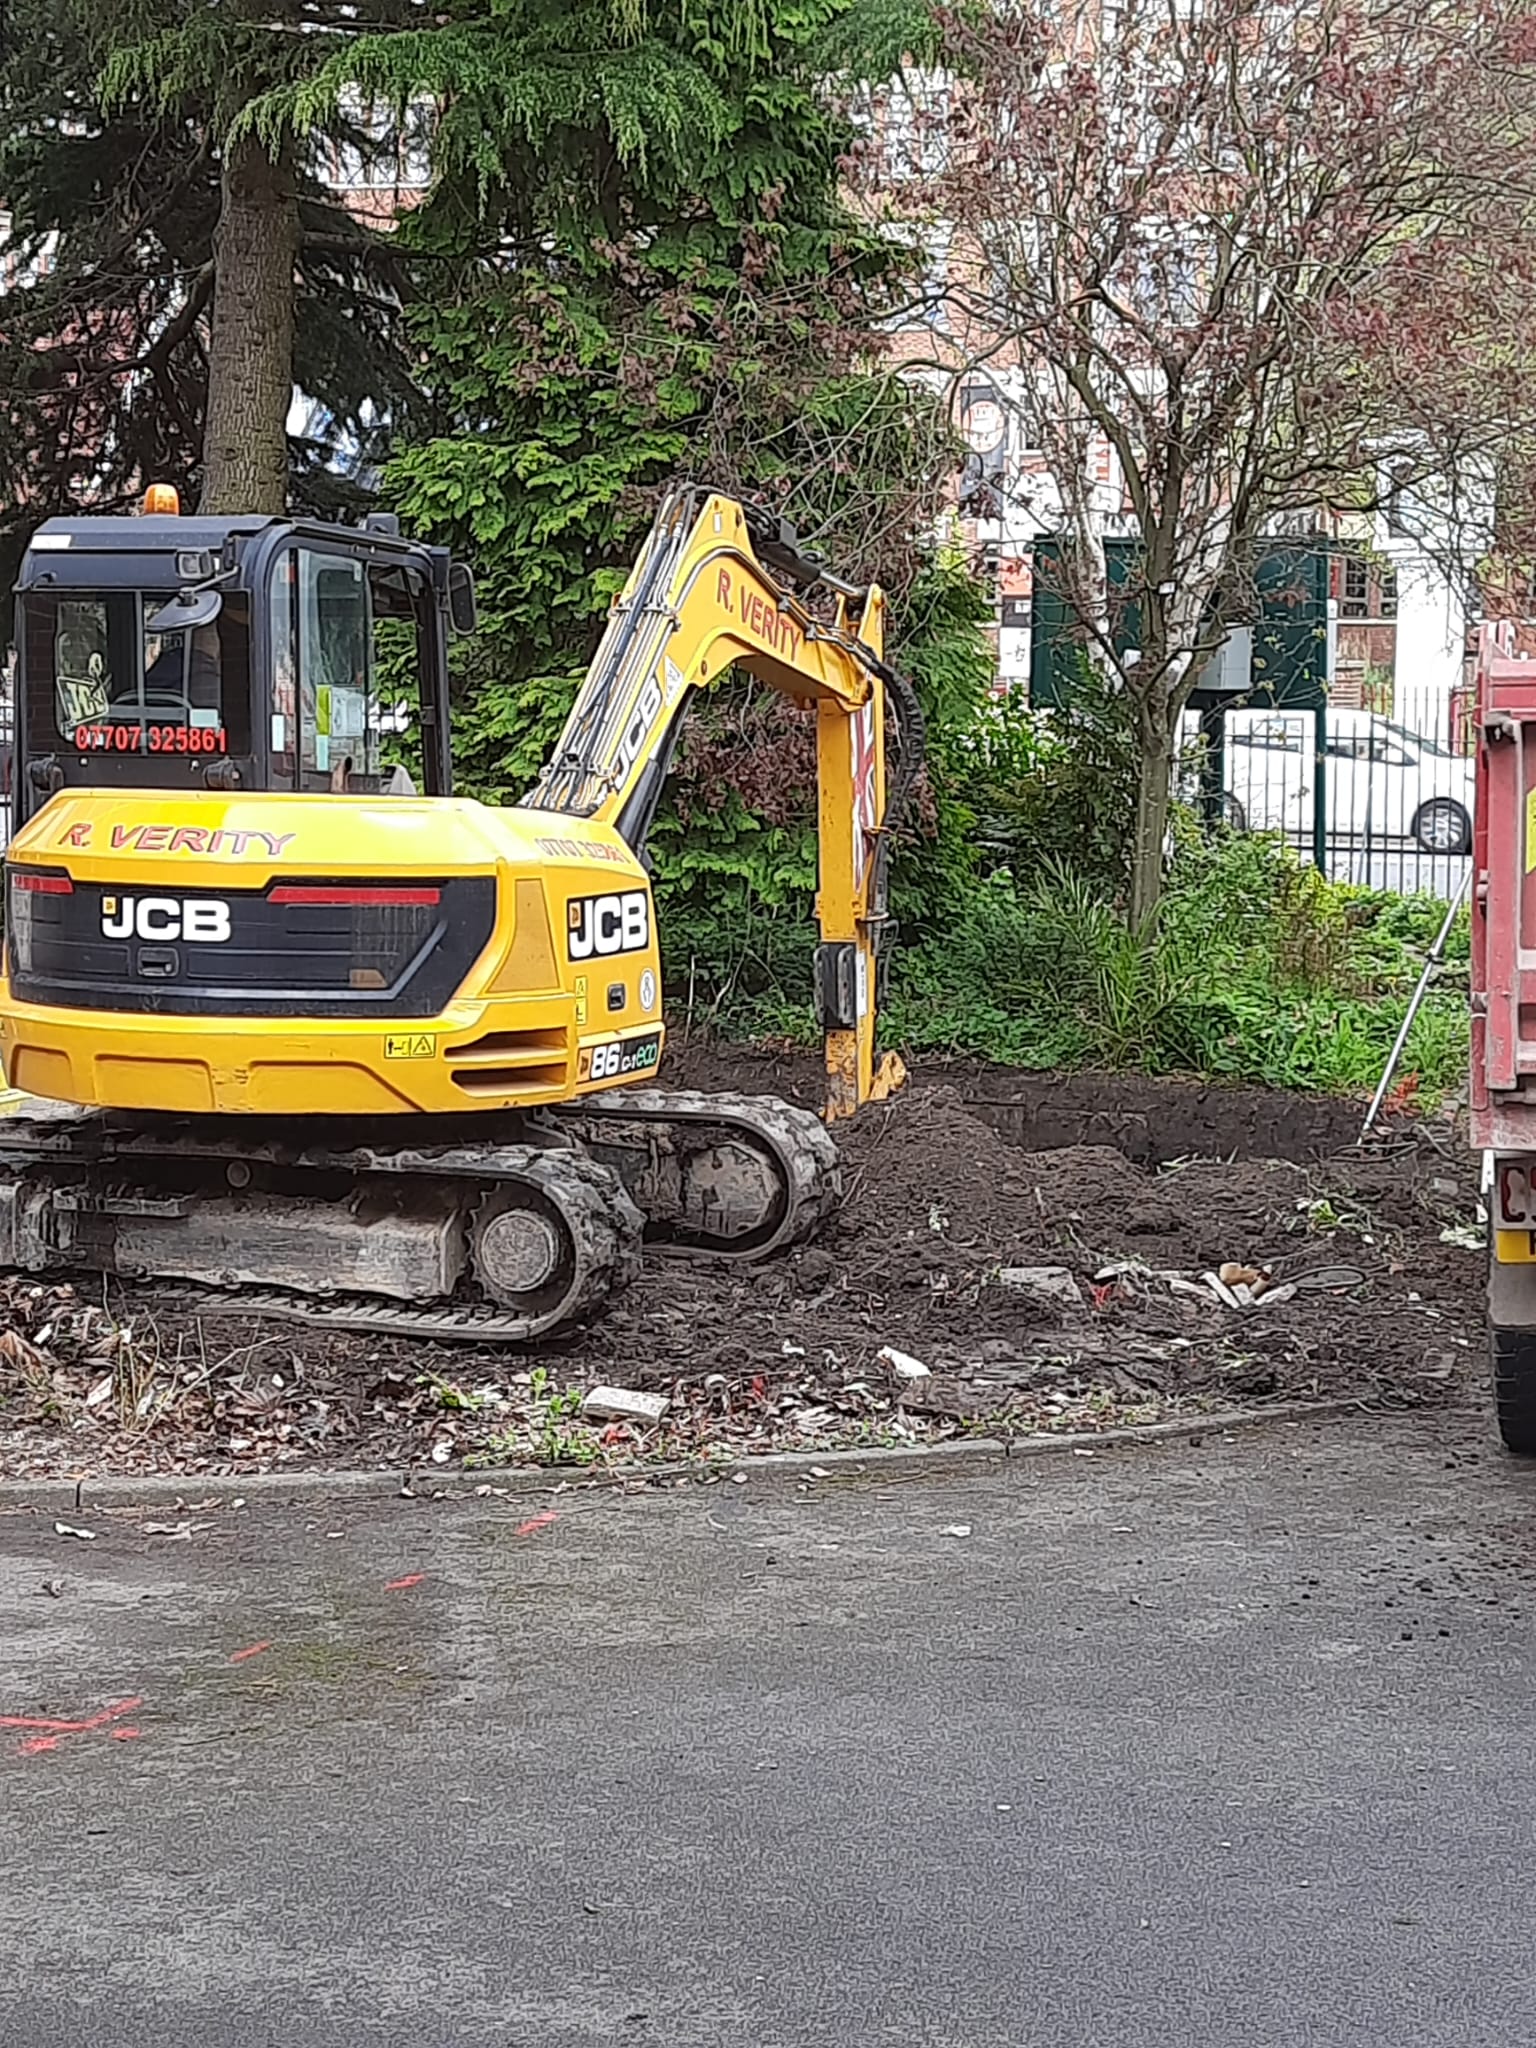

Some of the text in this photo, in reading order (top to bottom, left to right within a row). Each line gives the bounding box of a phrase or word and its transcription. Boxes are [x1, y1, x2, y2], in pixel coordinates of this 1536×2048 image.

[717, 567, 801, 662] R. VERITY
[75, 726, 226, 753] 07707 325861
[614, 676, 662, 790] JCB
[57, 822, 297, 856] R. VERITY
[101, 896, 232, 943] JCB
[568, 892, 648, 959] JCB
[590, 1042, 621, 1079] 86
[636, 1042, 657, 1067] eco
